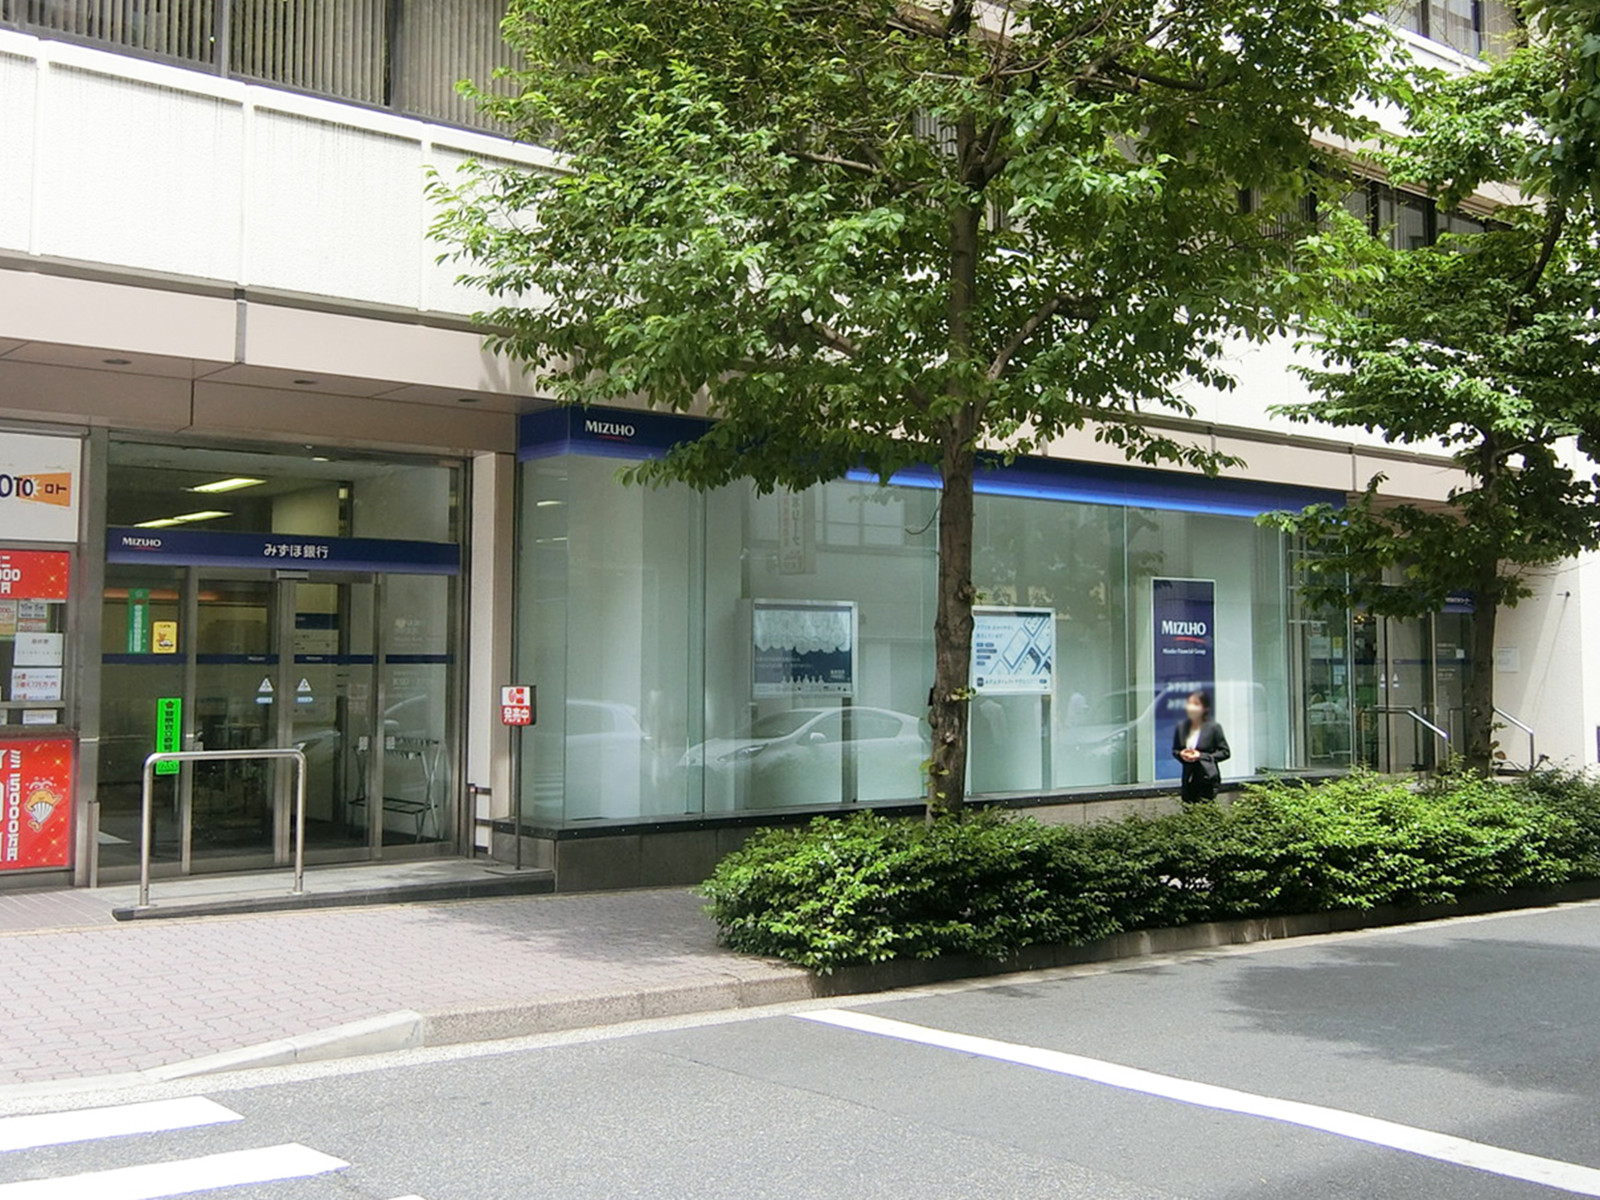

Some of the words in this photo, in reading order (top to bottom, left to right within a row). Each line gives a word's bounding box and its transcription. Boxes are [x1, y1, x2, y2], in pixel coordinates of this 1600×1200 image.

[585, 420, 635, 437] MIZUHO
[122, 536, 161, 547] MIZUHO
[263, 543, 329, 558] みずほ銀行
[1161, 620, 1207, 635] MIZUHO
[503, 707, 530, 723] 発売中
